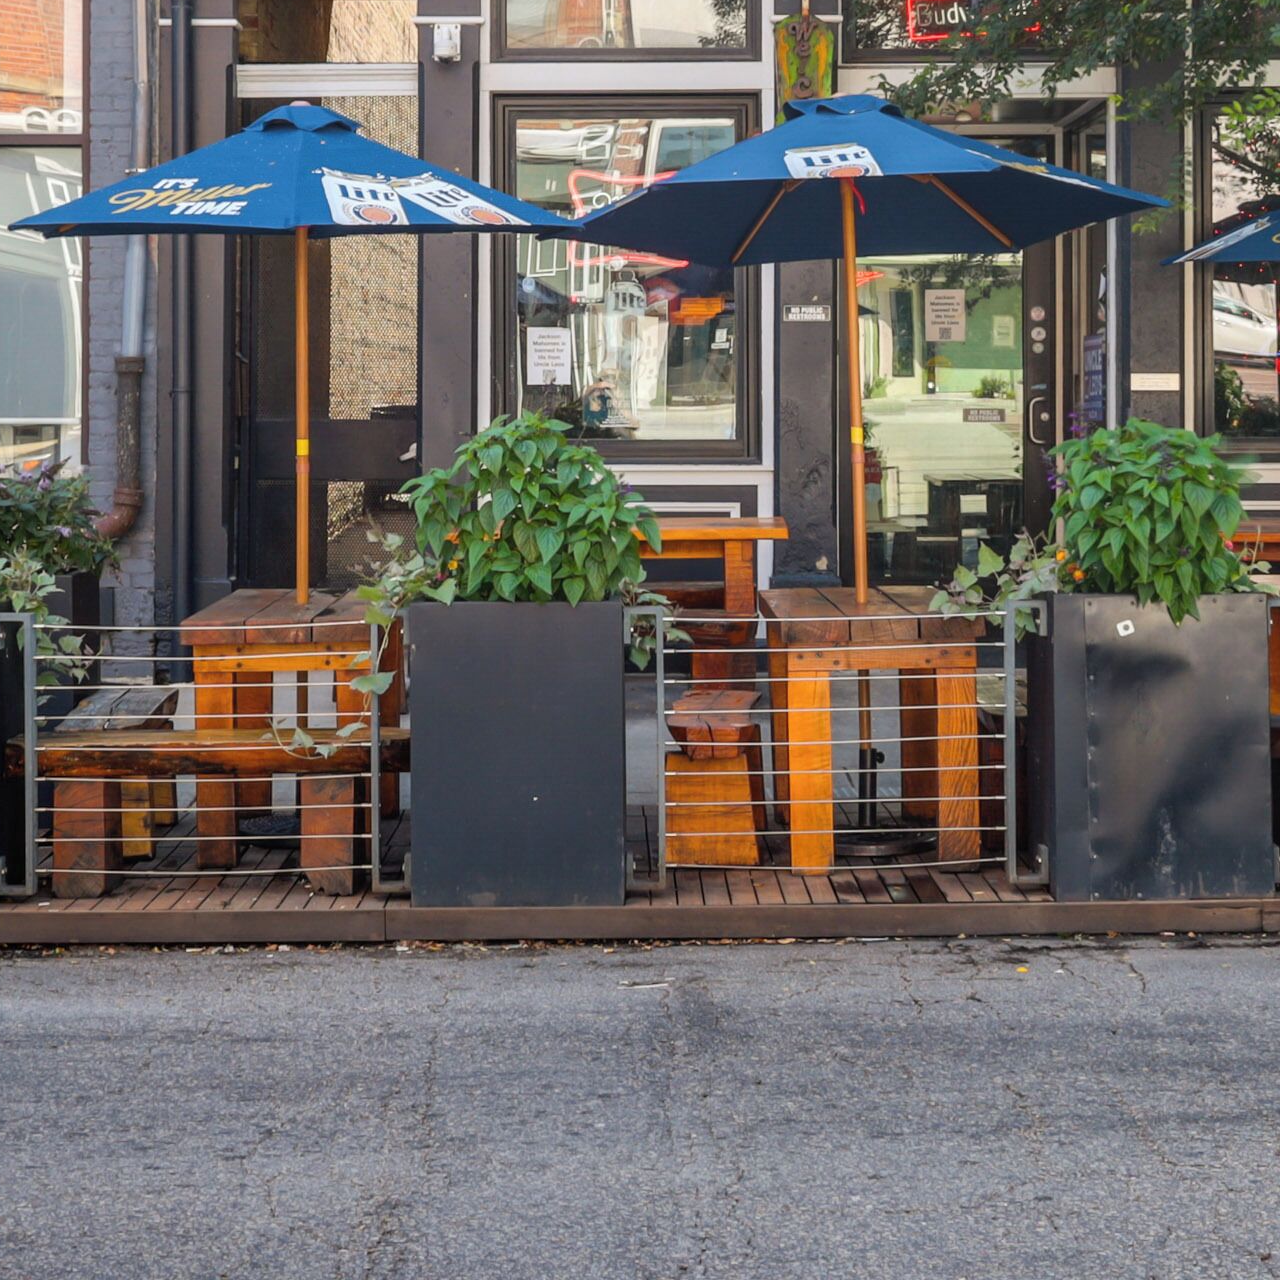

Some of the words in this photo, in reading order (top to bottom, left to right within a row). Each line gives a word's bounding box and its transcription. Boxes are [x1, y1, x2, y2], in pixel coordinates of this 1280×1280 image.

[802, 150, 867, 168] Lite
[152, 177, 200, 190] IT'S
[337, 183, 396, 203] Lite
[108, 182, 273, 215] Miller
[413, 187, 471, 208] Lite
[170, 201, 249, 216] TIME
